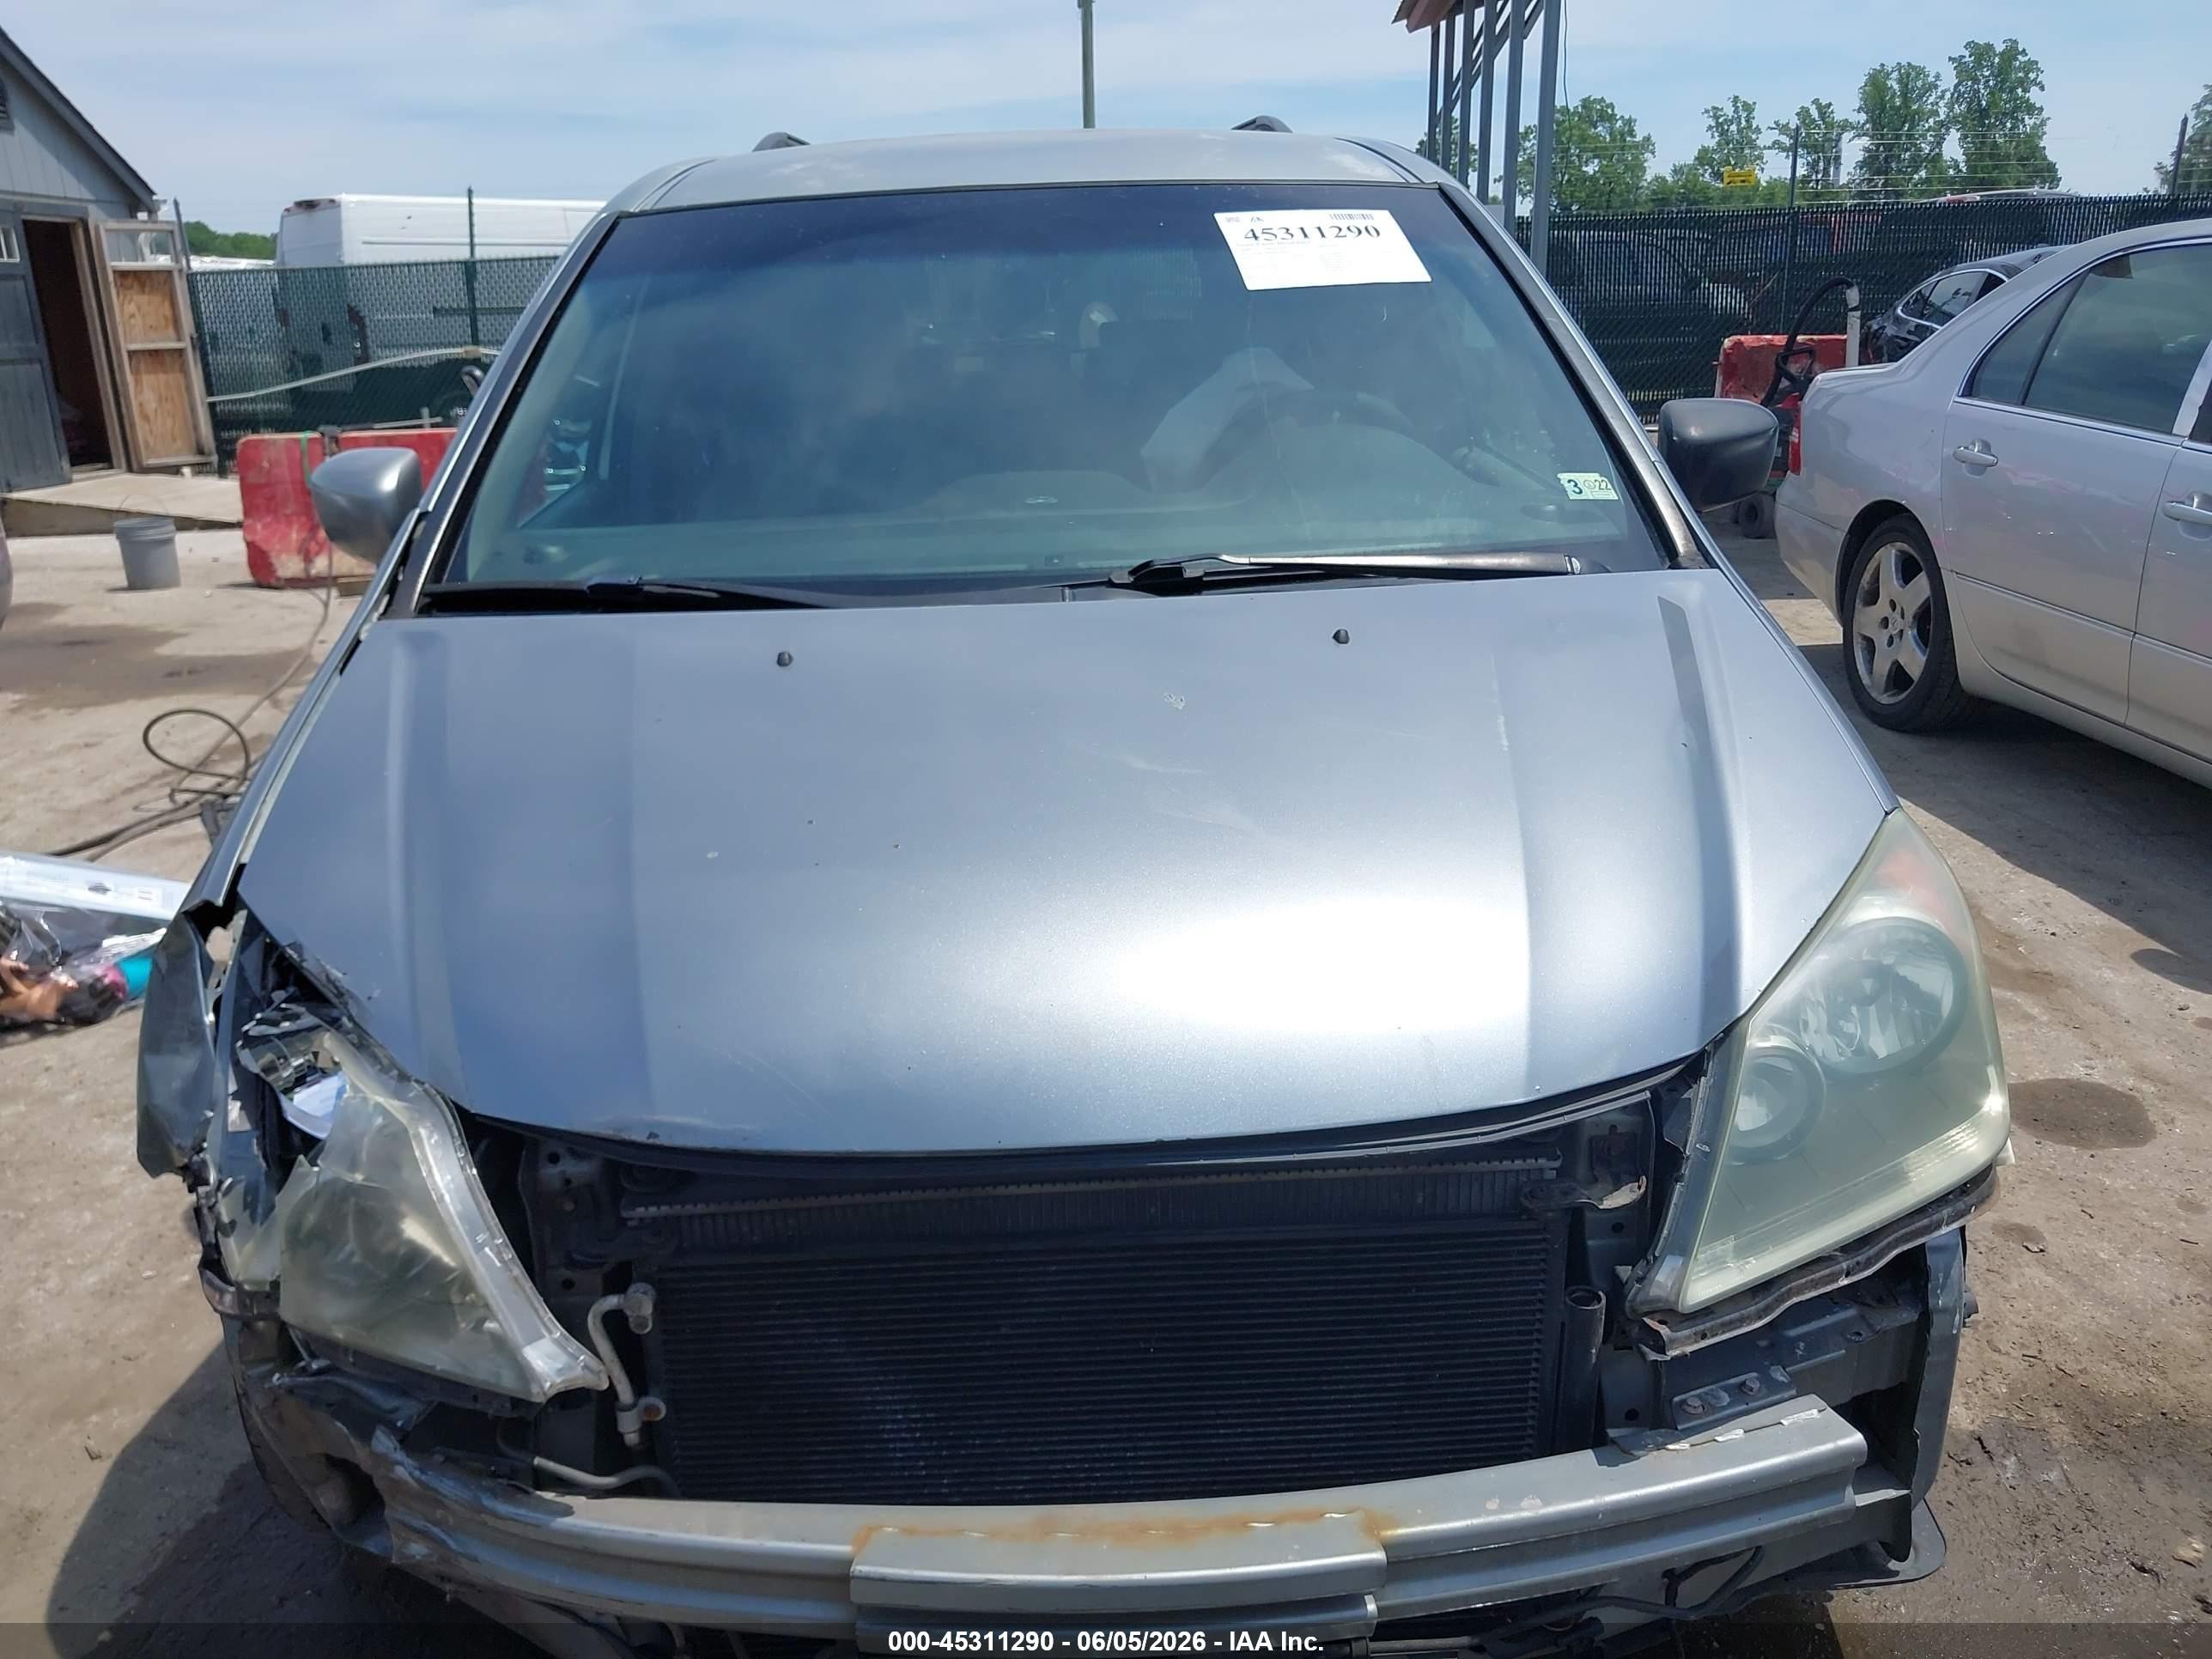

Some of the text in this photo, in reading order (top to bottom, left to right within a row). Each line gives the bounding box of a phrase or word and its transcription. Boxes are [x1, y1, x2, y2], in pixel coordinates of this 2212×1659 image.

[1243, 224, 1382, 241] 45311290
[1567, 479, 1612, 495] 3 22
